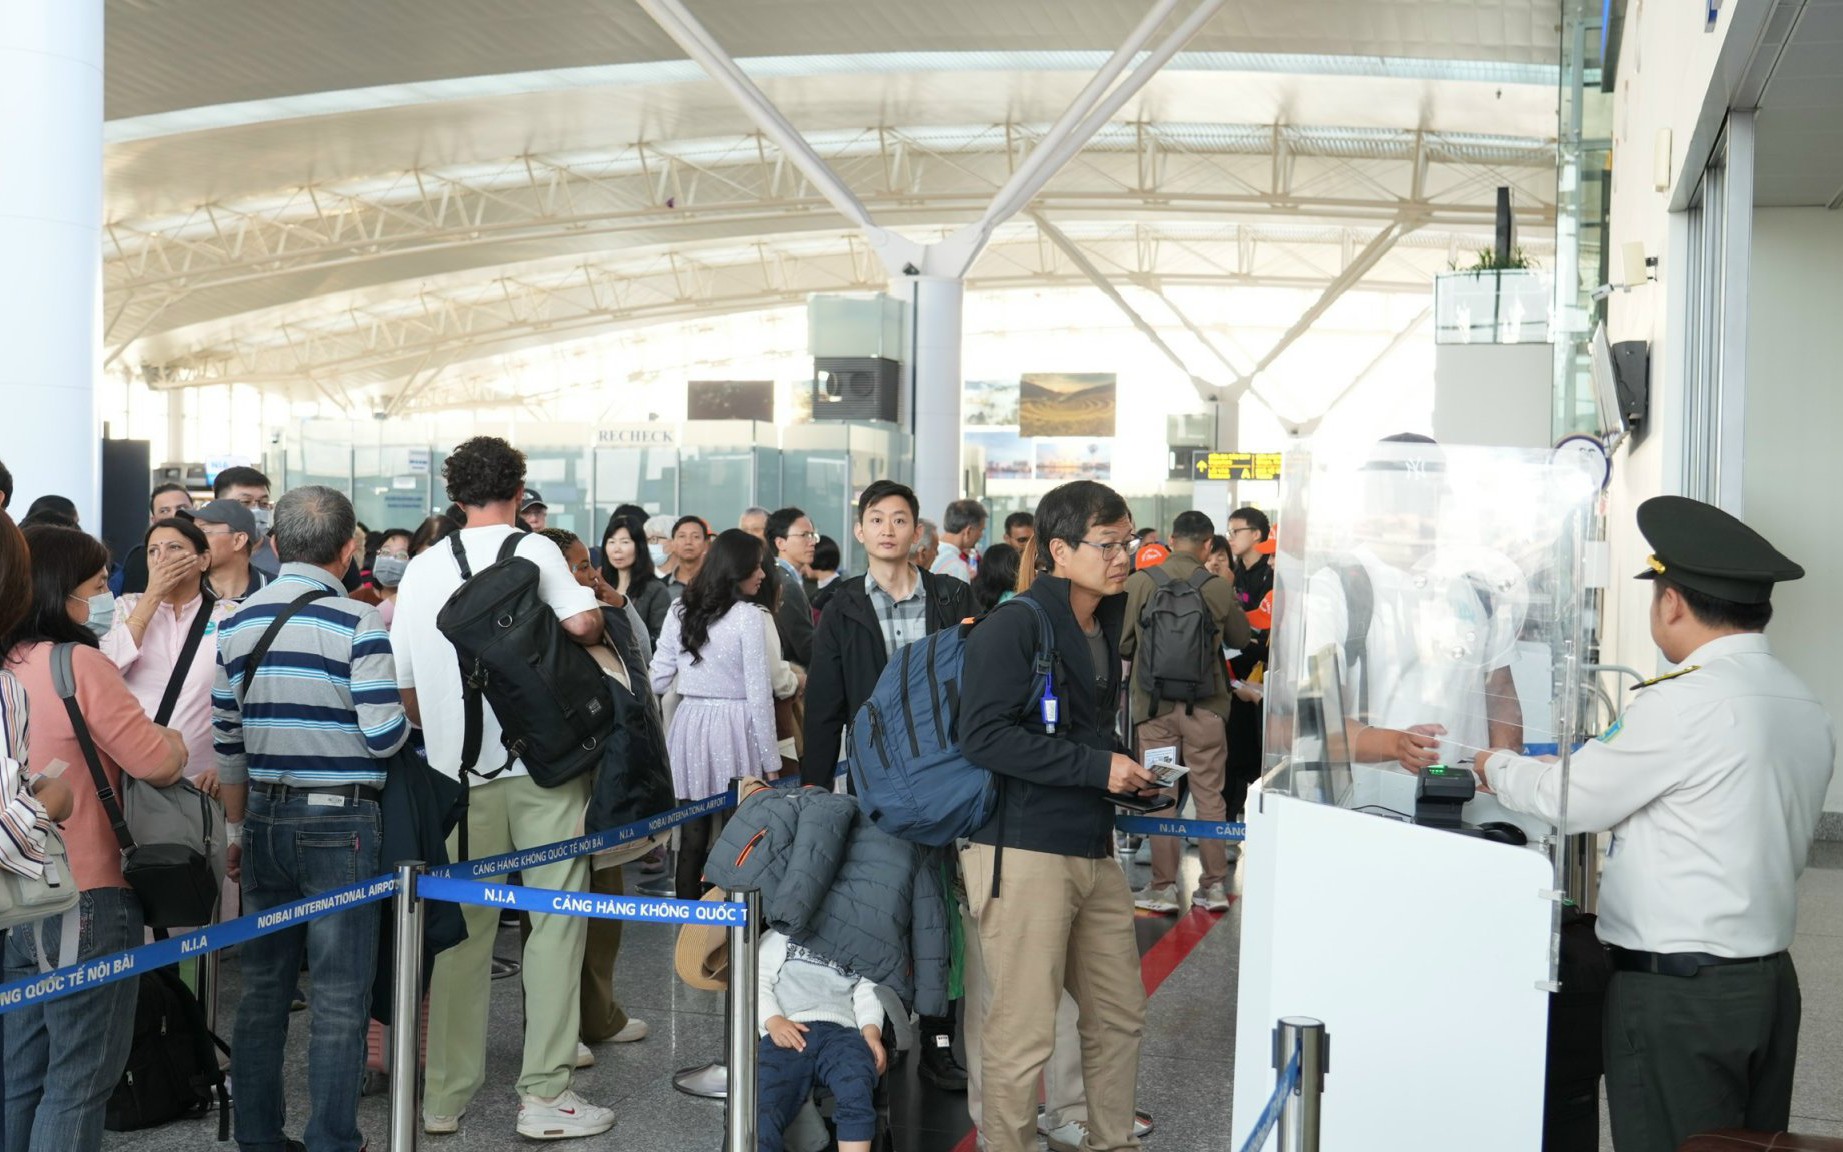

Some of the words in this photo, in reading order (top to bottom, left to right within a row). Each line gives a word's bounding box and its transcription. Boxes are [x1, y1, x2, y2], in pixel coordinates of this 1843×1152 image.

[599, 430, 674, 442] RECHECK
[668, 804, 705, 824] INTERNATIONAL
[707, 797, 726, 810] AIRPORT
[1159, 823, 1187, 834] N.I.A
[484, 888, 516, 904] N.I.A
[552, 894, 593, 913] CẢNG
[596, 900, 636, 916] HÀNG
[640, 902, 689, 918] KHÔNG
[695, 903, 736, 921] QUỐC
[740, 908, 748, 921] T
[25, 973, 65, 999] QUỐC
[68, 964, 86, 987] TẾ
[87, 961, 110, 982] NỘI
[113, 954, 134, 974] BÀI
[181, 935, 208, 953] N.I.A
[257, 908, 292, 929] NOIBAI
[294, 889, 366, 918] INTERNATIONAL
[368, 879, 400, 897] AIRPO
